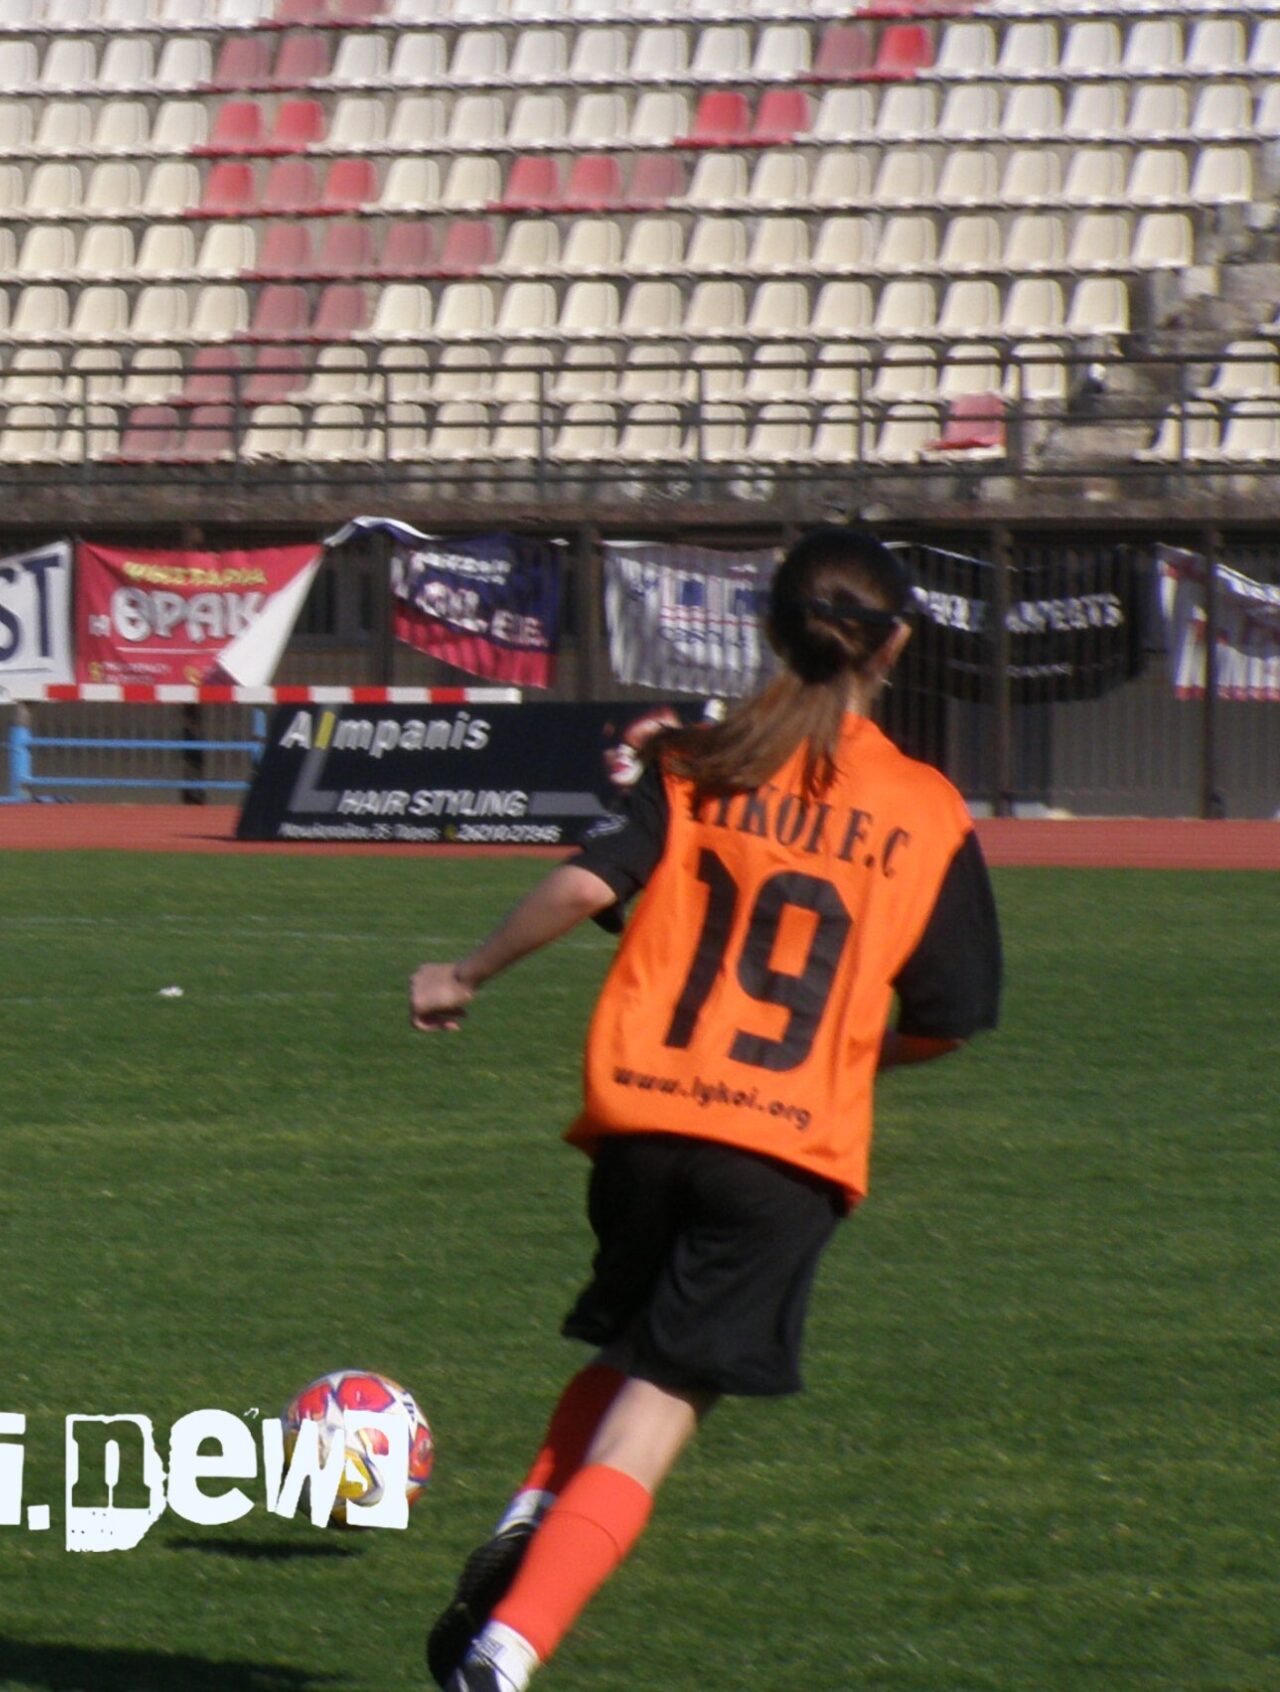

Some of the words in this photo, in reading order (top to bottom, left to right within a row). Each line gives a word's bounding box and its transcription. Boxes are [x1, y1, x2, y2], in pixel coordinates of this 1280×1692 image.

[336, 789, 410, 816] HAIR
[407, 789, 529, 817] STYLING
[688, 780, 833, 855] KOI
[664, 845, 853, 1074] 19
